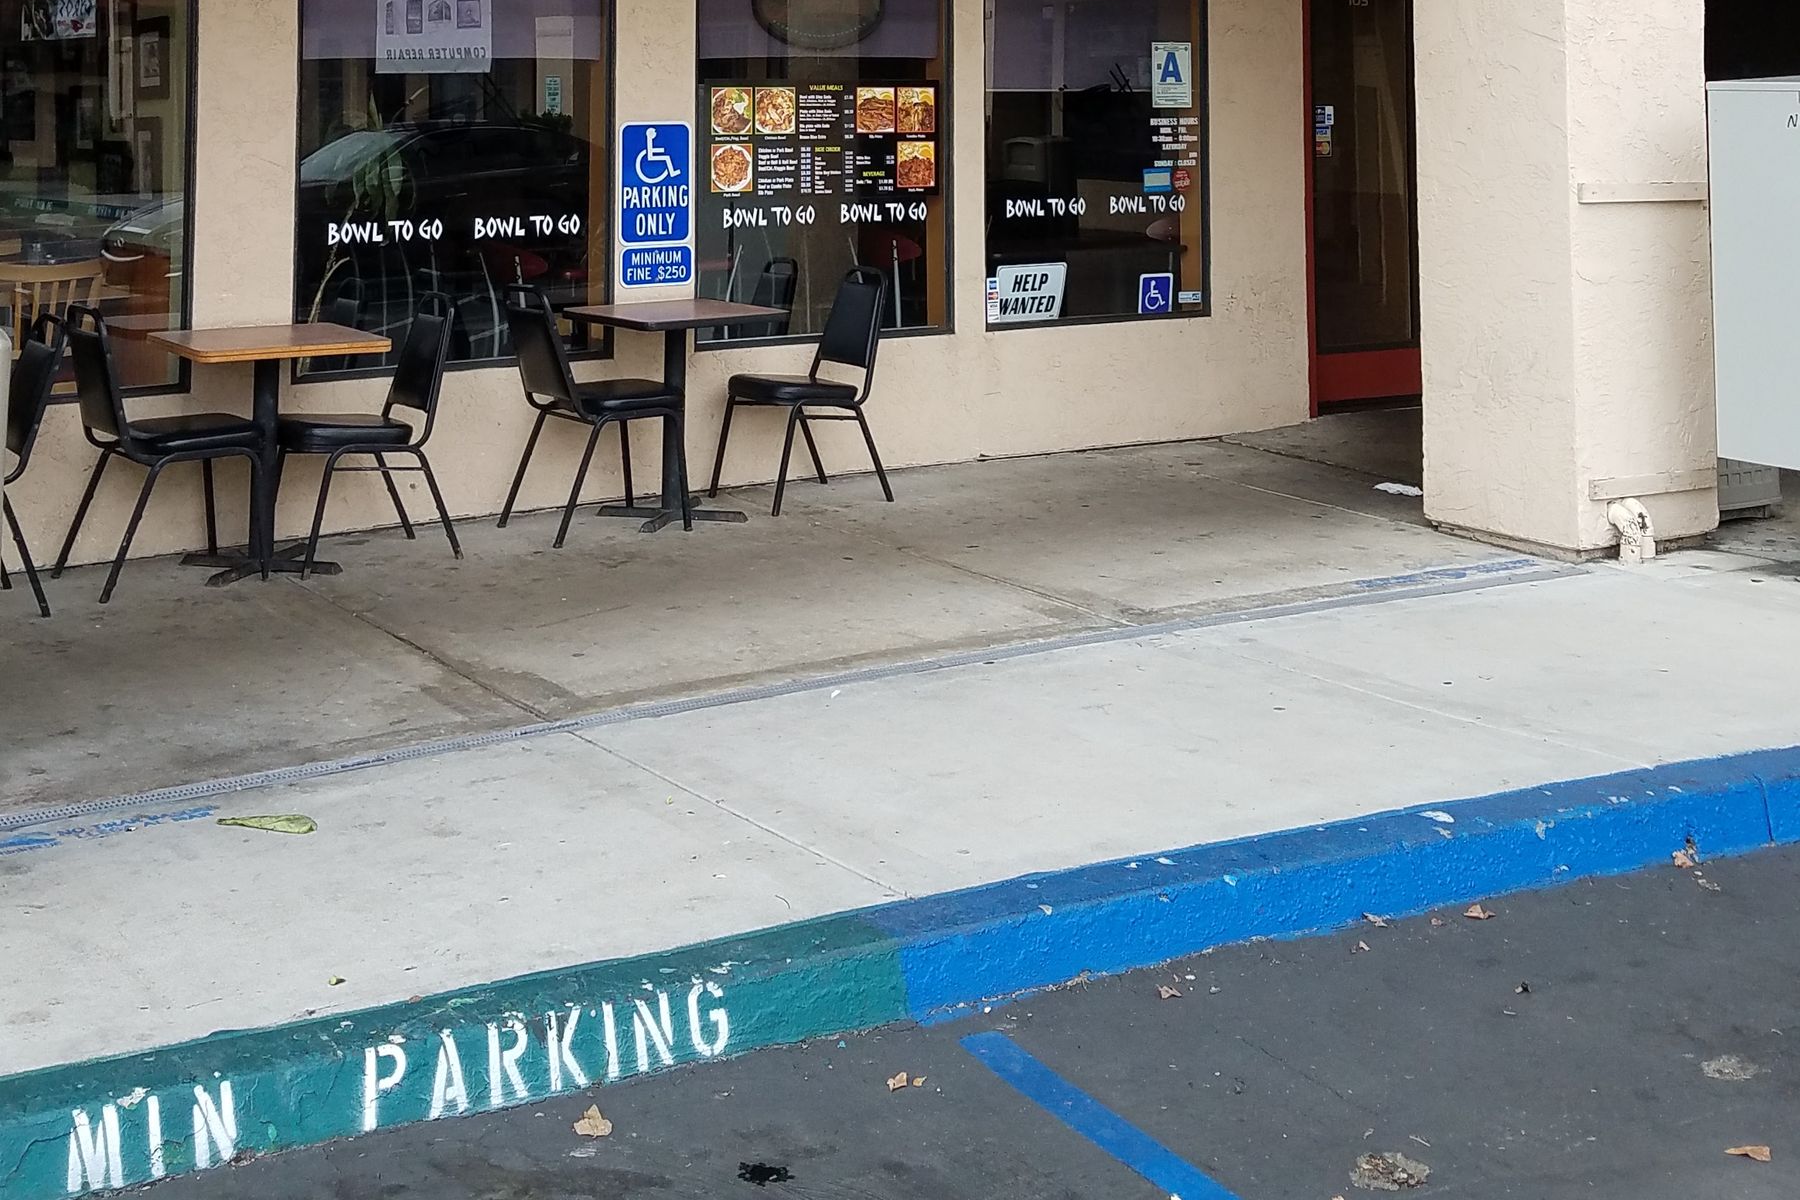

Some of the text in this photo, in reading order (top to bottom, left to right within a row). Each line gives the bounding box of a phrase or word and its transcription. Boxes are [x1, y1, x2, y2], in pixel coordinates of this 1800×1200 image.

[1159, 51, 1183, 83] A
[622, 184, 689, 210] PARKING
[1006, 196, 1087, 219] BOWL TO GO
[1109, 194, 1186, 215] BOWL TO GO
[635, 212, 676, 236] ONLY
[723, 204, 816, 229] BOWL TO GO
[840, 201, 928, 224] BOWL TO GO
[328, 217, 443, 246] BOWL TO GO
[474, 213, 581, 240] BOWL TO GO
[631, 250, 682, 266] MINIMUM
[627, 265, 687, 281] FINE $250
[1011, 272, 1049, 293] HELP
[999, 295, 1056, 316] WANTED
[66, 980, 731, 1193] MIN PARKING
